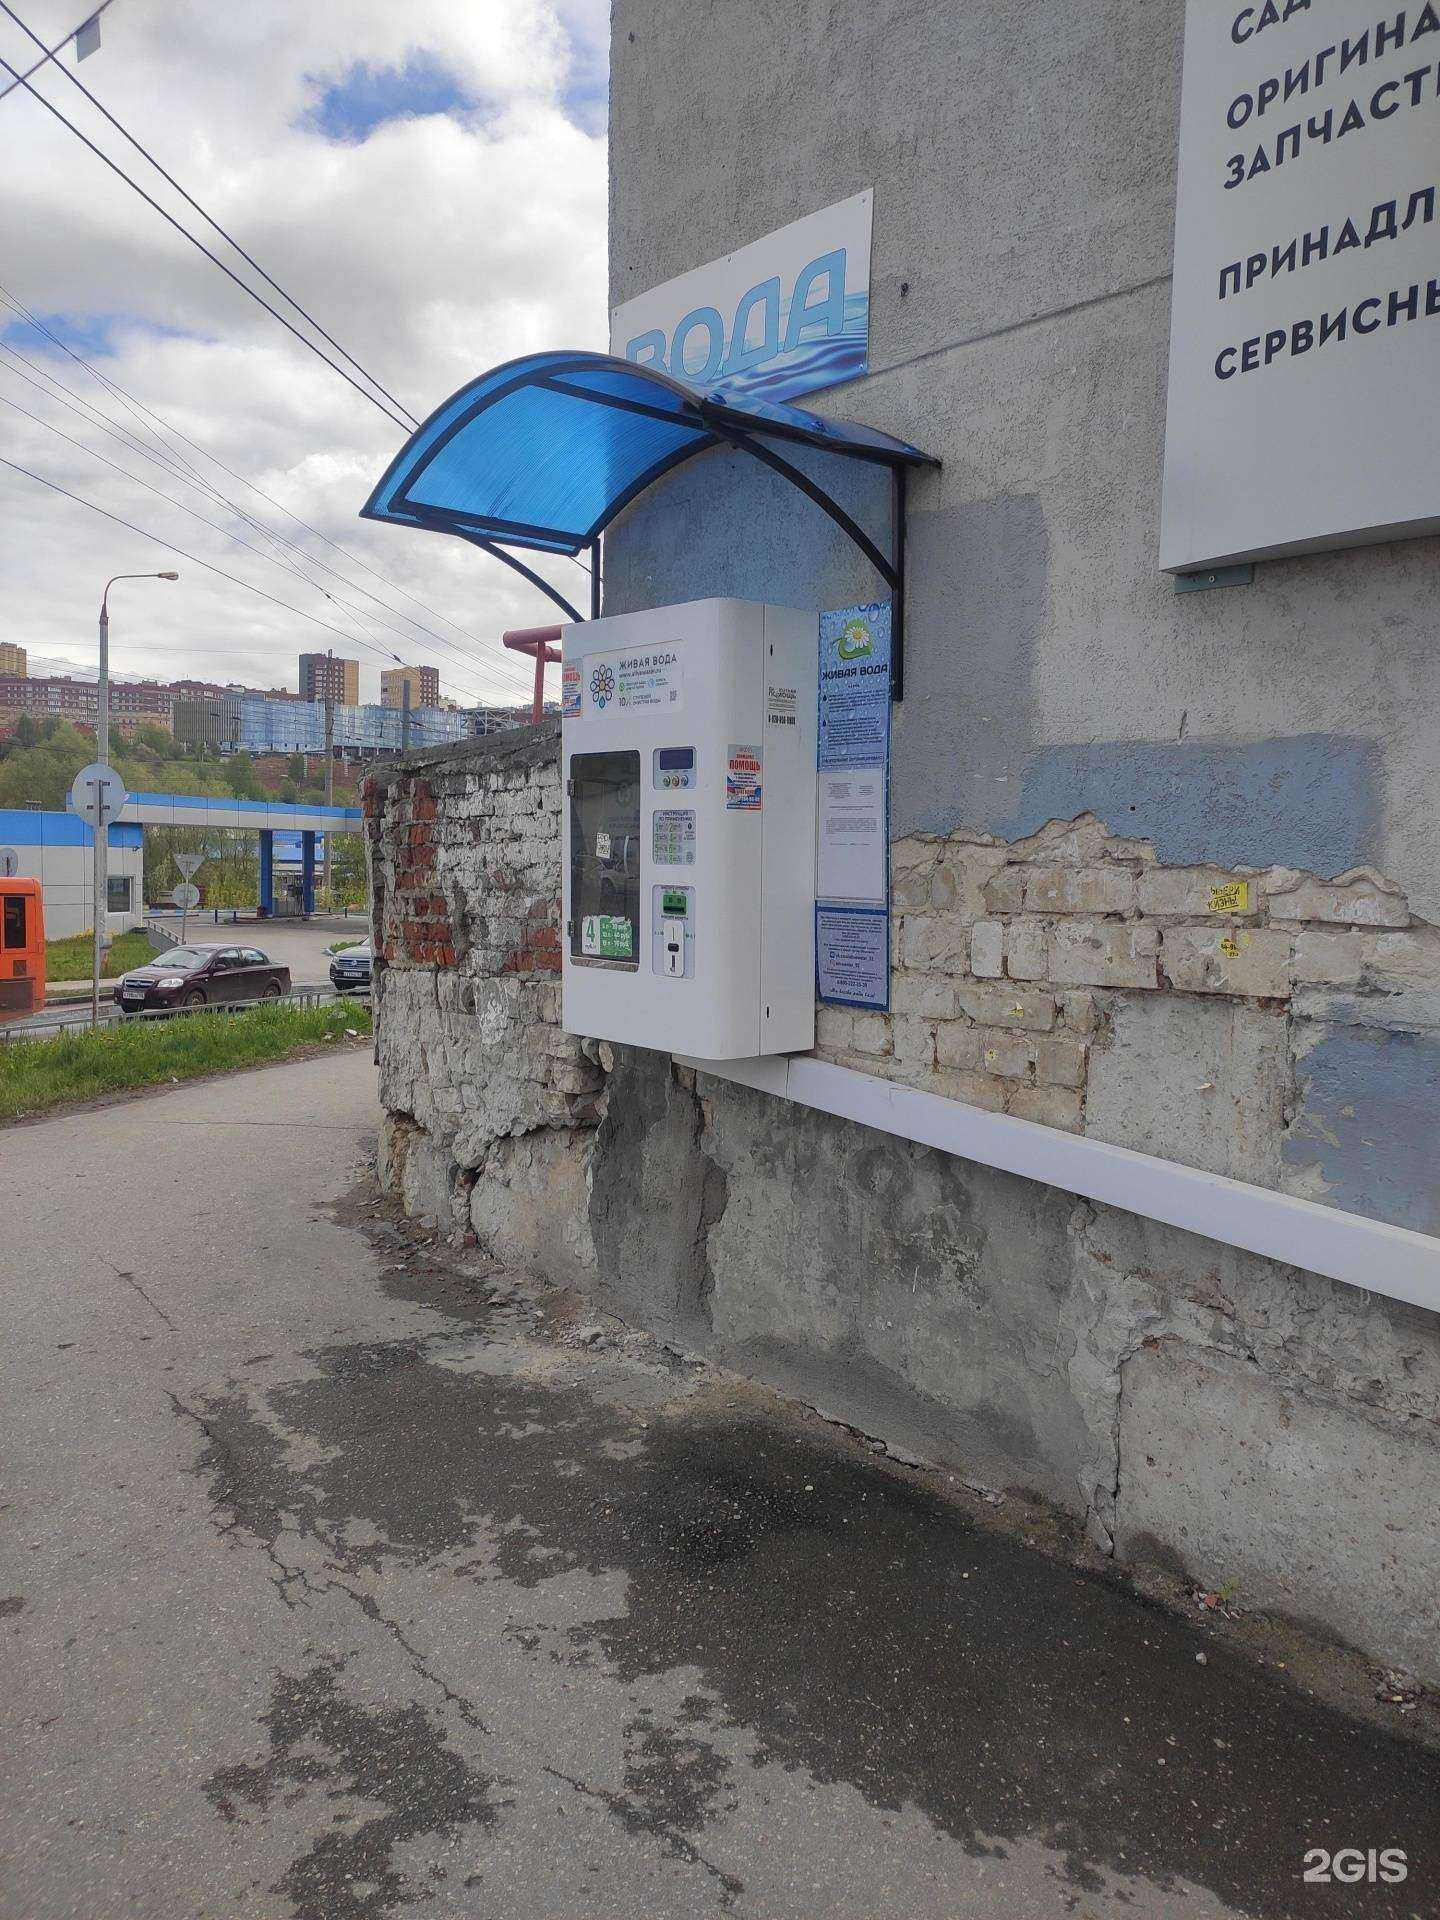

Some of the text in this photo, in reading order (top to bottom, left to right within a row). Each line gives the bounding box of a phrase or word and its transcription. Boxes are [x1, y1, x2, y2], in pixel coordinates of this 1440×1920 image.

[1226, 0, 1440, 129] ОРИГИНА
[1223, 61, 1440, 190] ЗАПЧАСТ
[1218, 186, 1435, 300] ПРИНАДЛ
[619, 654, 678, 671] ЖИВАЯ ВОДА
[822, 664, 888, 681] ЖИВАЯ ВОДА
[729, 760, 760, 771] ПОМОЩЬ
[586, 918, 595, 942] 4
